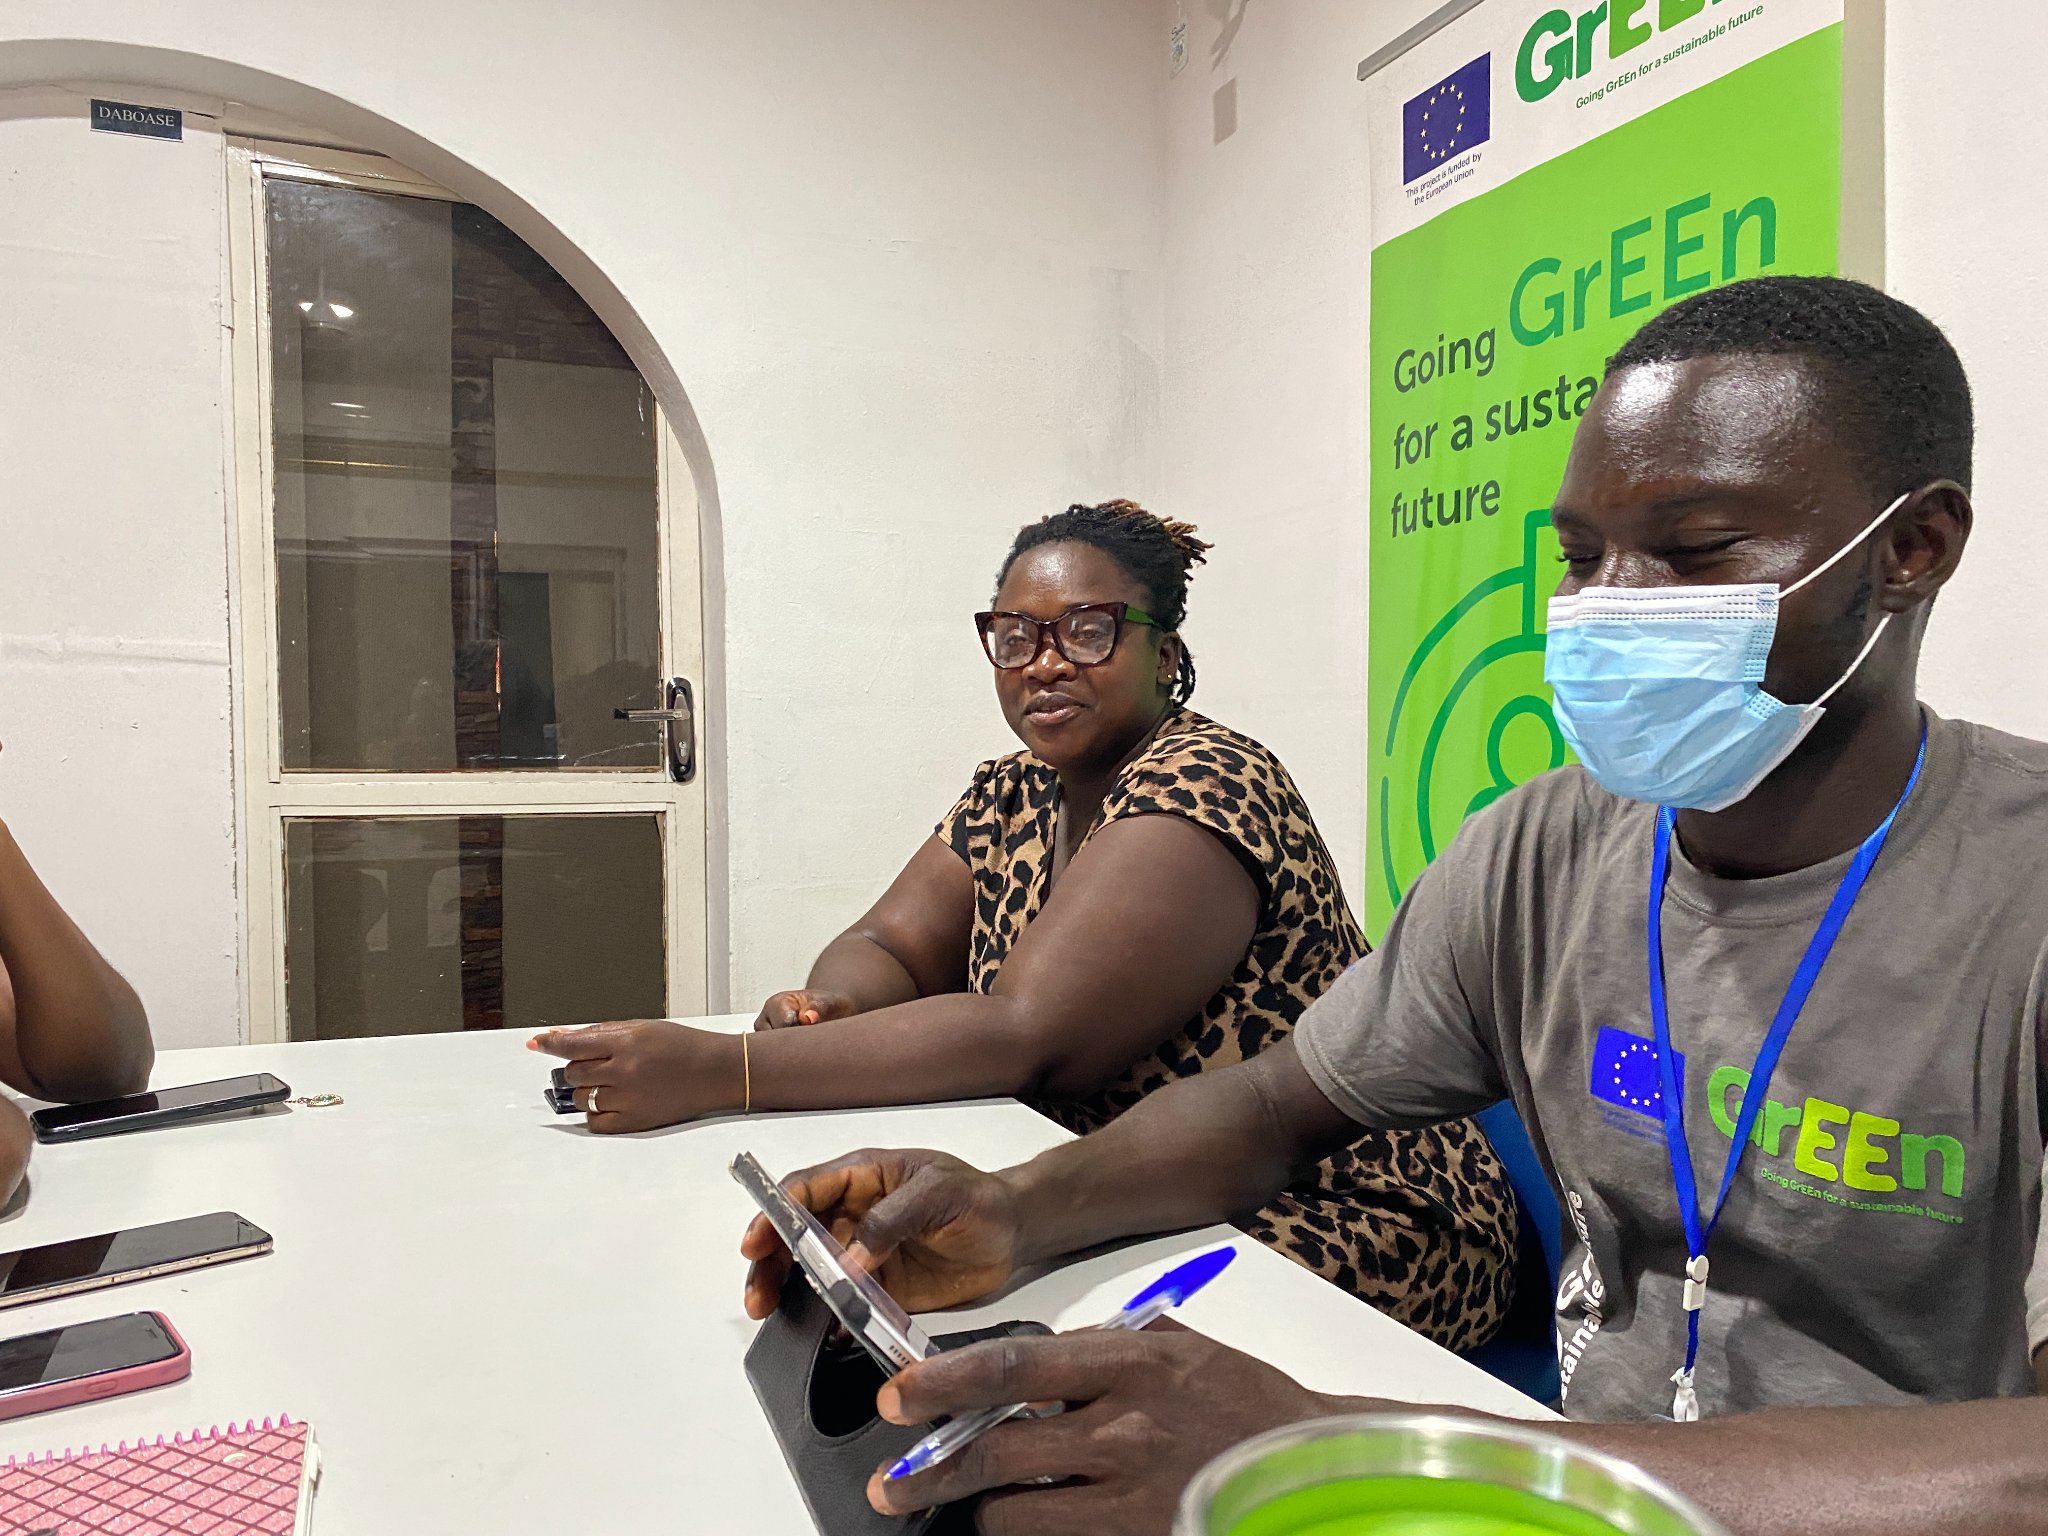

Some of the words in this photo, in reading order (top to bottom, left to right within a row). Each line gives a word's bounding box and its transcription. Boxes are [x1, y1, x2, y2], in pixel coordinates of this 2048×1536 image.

[1576, 87, 1604, 109] Going
[1606, 71, 1637, 93] GrEEn
[1638, 62, 1653, 80] for
[1655, 58, 1662, 69] a
[1663, 24, 1726, 65] sustainable
[1728, 5, 1764, 32] future
[99, 106, 175, 127] DABOASE
[1405, 187, 1419, 198] This
[1420, 173, 1441, 193] project
[1442, 169, 1447, 178] is
[1447, 156, 1470, 175] funded
[1472, 152, 1482, 163] by
[1414, 195, 1425, 206] the
[1425, 178, 1453, 200] European
[1454, 168, 1474, 183] Union
[1394, 327, 1496, 394] Going
[1509, 192, 1777, 347] GrEEn
[1393, 414, 1438, 469] for
[1450, 413, 1474, 452] a
[1486, 356, 1613, 442] susta
[1391, 480, 1500, 538] future
[1707, 1065, 1965, 1198] GrEEn
[1760, 1168, 1789, 1189] Going
[1790, 1178, 1822, 1199] GrEEn
[1823, 1190, 1839, 1203] for
